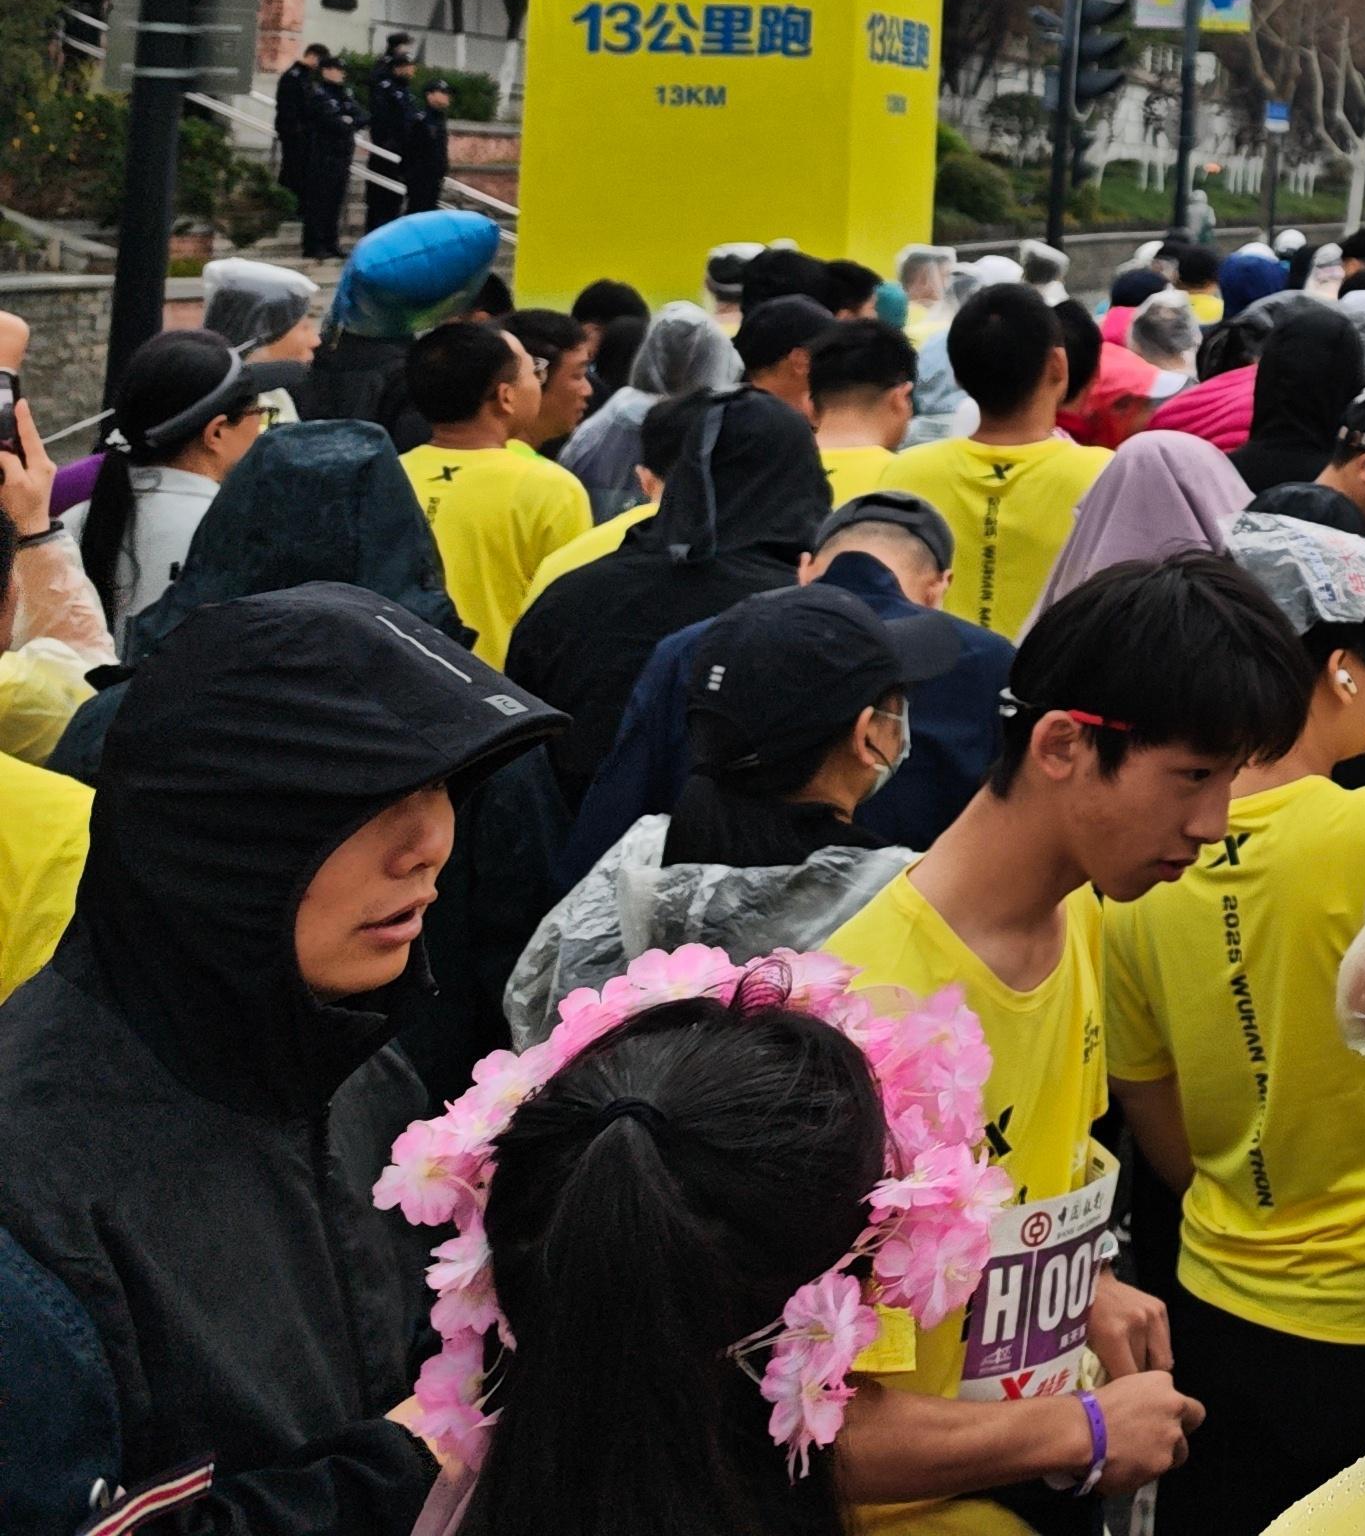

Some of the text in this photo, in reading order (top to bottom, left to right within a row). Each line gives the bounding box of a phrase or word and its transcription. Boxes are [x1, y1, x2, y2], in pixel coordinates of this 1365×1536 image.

[573, 2, 813, 58] 13公里跑
[867, 12, 931, 69] 13公里跑
[655, 85, 727, 107] 13KM
[1223, 895, 1243, 964] 2025
[1230, 973, 1267, 1062] WUHAN
